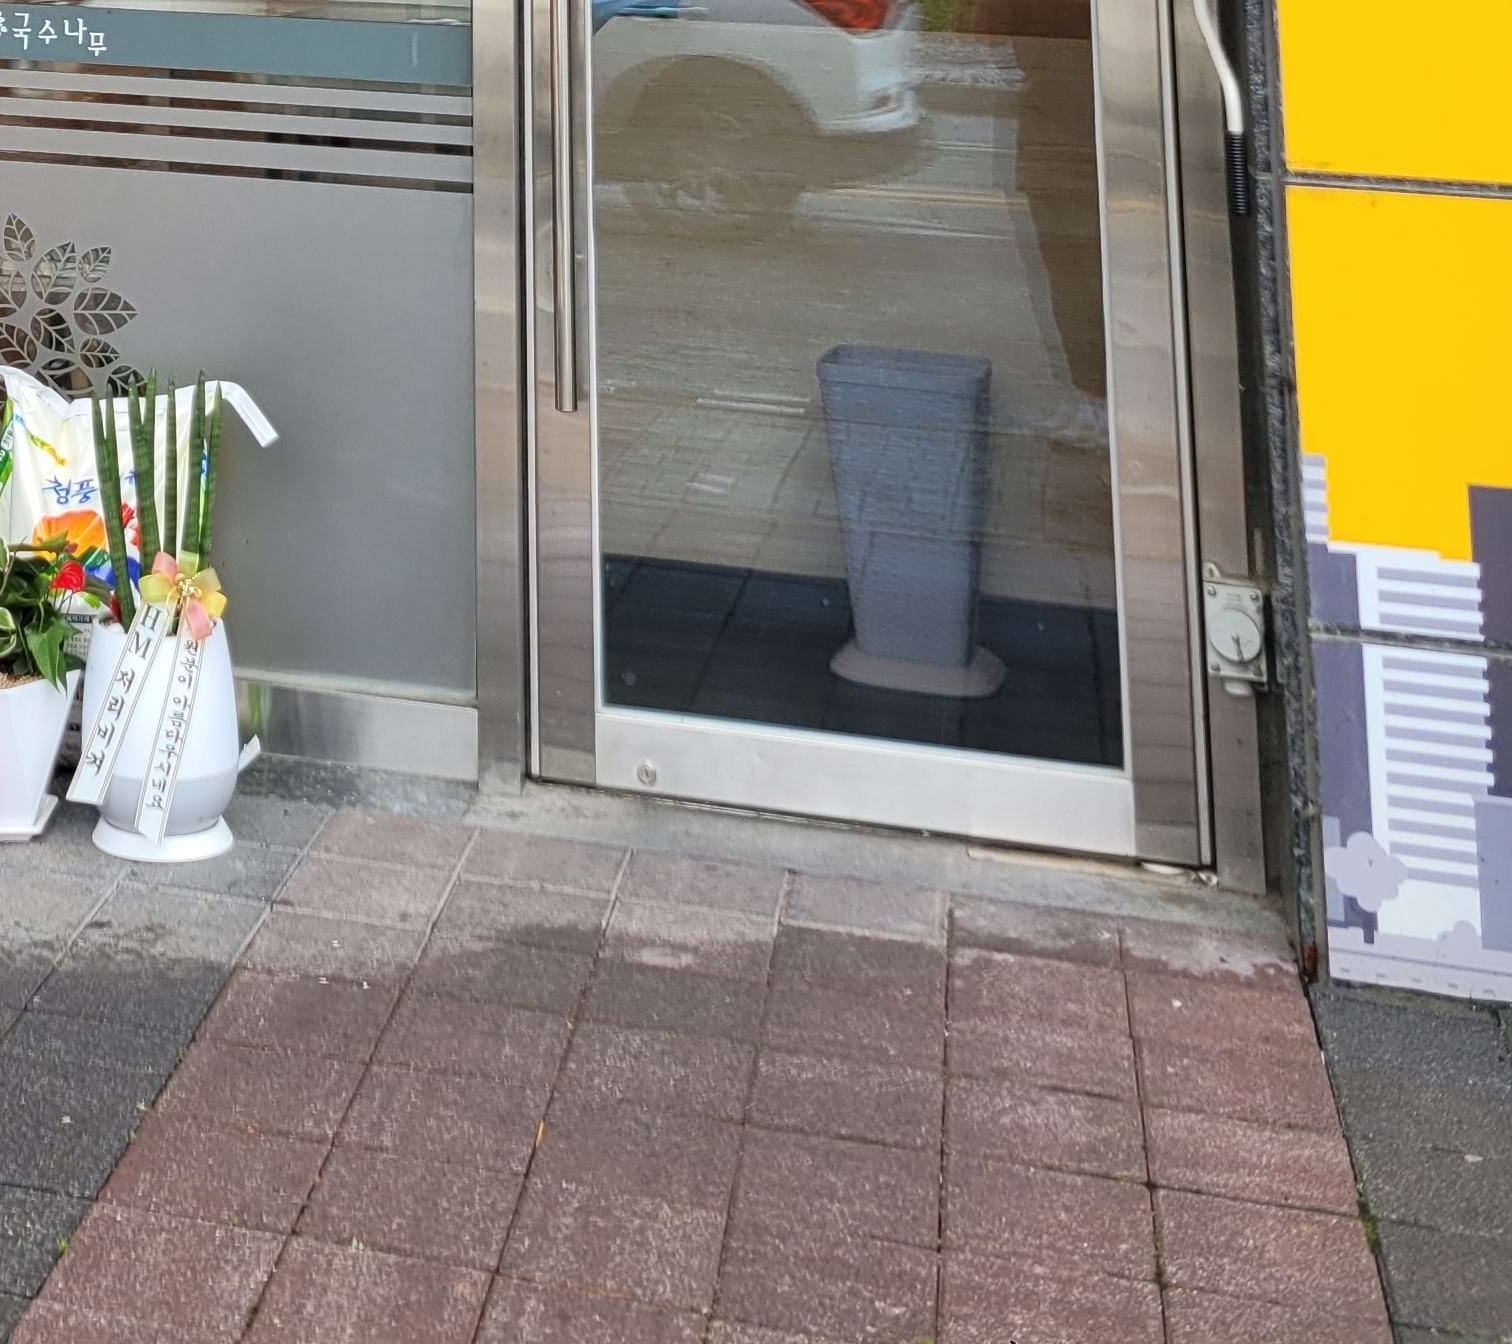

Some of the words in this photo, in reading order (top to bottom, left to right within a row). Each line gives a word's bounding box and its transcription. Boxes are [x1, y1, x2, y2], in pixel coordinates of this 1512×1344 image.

[12, 12, 107, 57] 국수나무
[127, 603, 163, 660] HM
[177, 626, 199, 690] 원분이
[145, 695, 189, 810] 아름다우시네요
